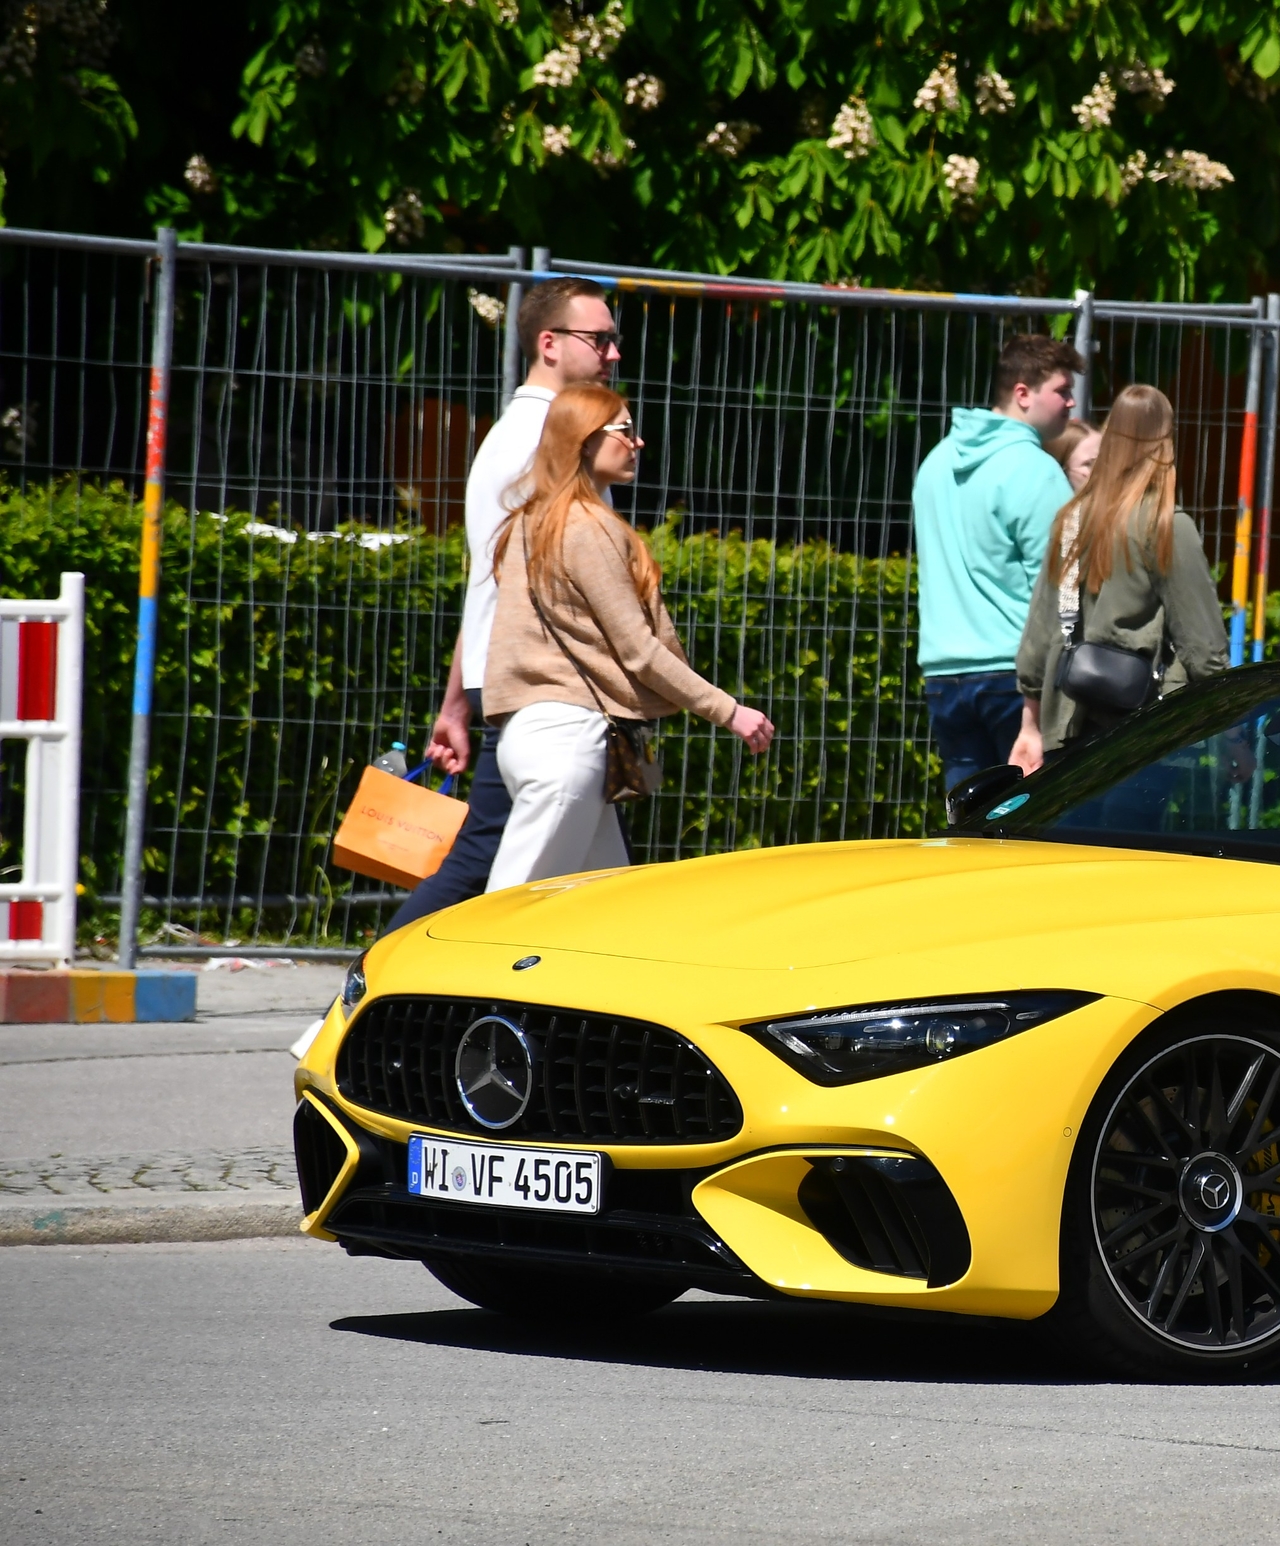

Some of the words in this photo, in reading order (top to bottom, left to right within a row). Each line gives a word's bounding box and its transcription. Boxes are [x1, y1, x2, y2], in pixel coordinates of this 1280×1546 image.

[361, 805, 394, 826] LOUIS
[398, 820, 446, 843] VUITTON
[411, 1171, 419, 1185] D
[424, 1146, 450, 1192] WI
[471, 1152, 505, 1198] VF
[514, 1157, 593, 1205] 4505
